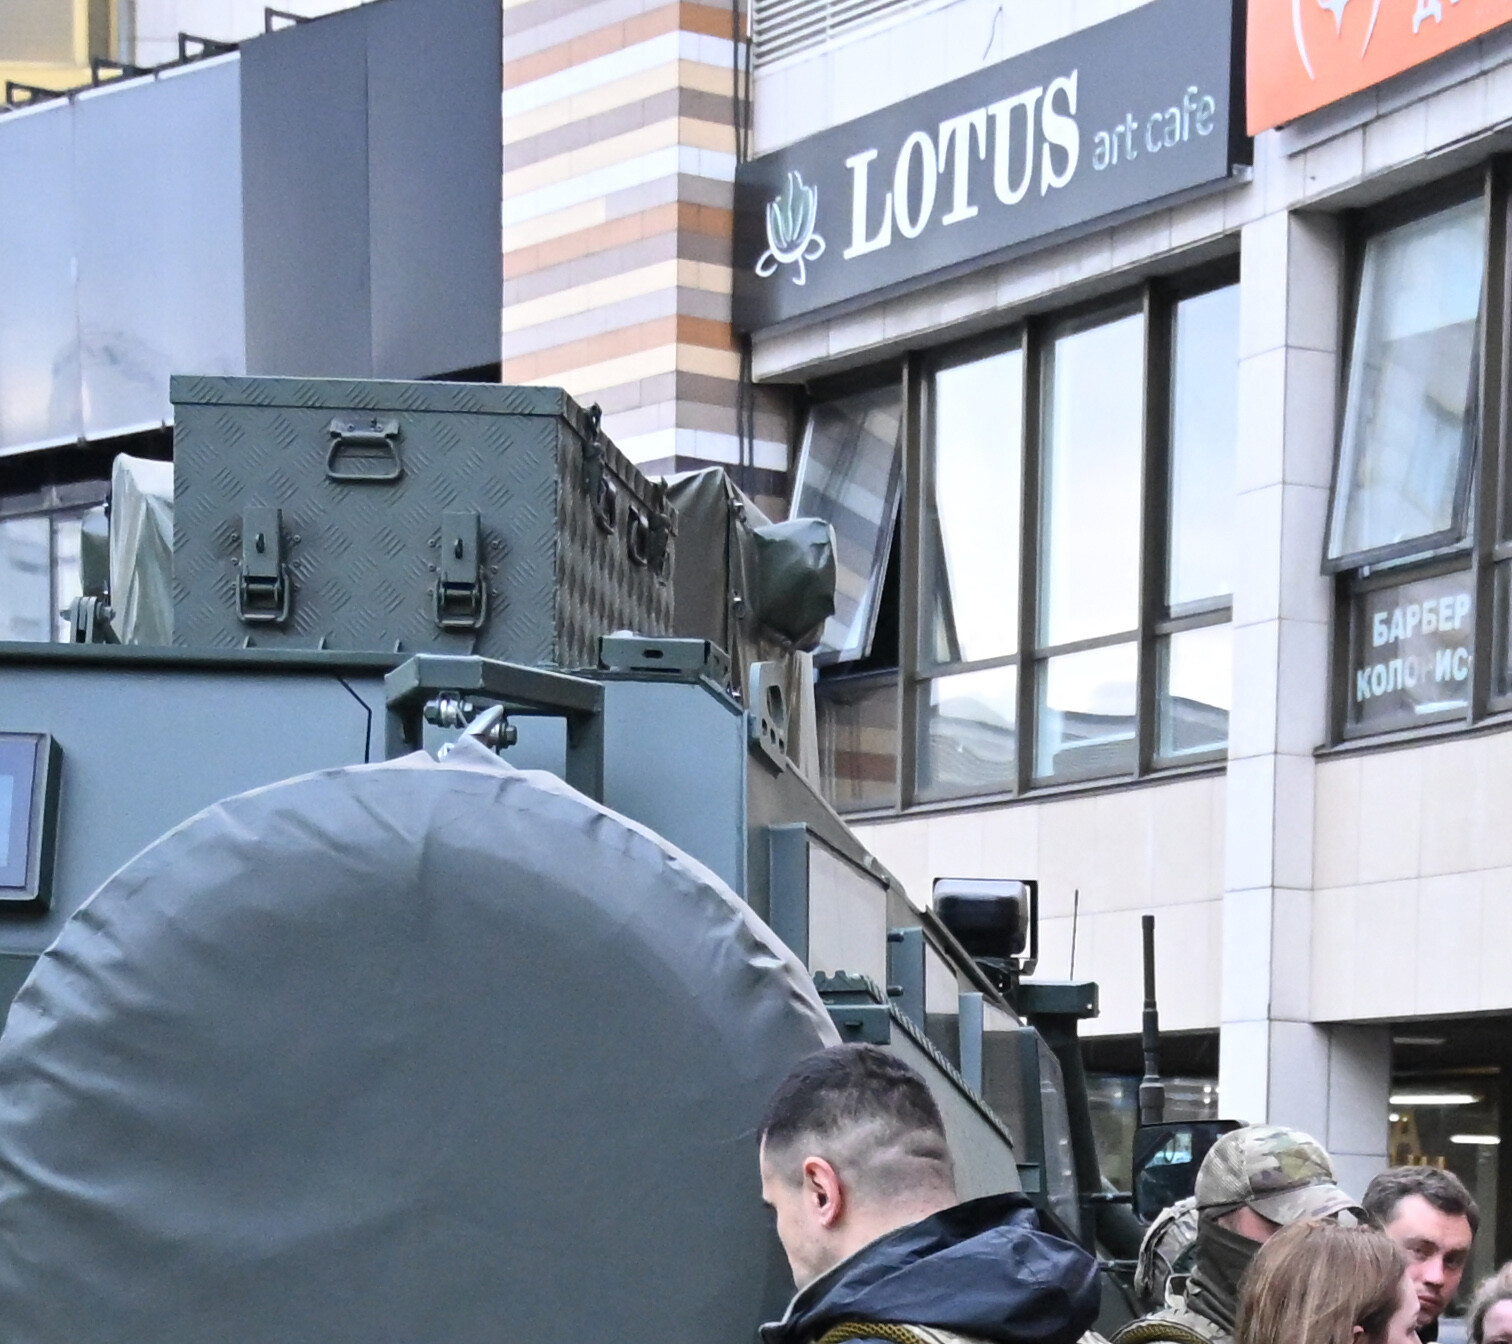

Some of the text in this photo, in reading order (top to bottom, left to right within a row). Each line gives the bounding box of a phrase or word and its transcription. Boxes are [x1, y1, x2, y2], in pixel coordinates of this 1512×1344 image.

[842, 68, 1216, 261] LOTUS art cafe
[1372, 592, 1472, 648] БАРБЕР
[1356, 646, 1473, 703] КОЛОИС
